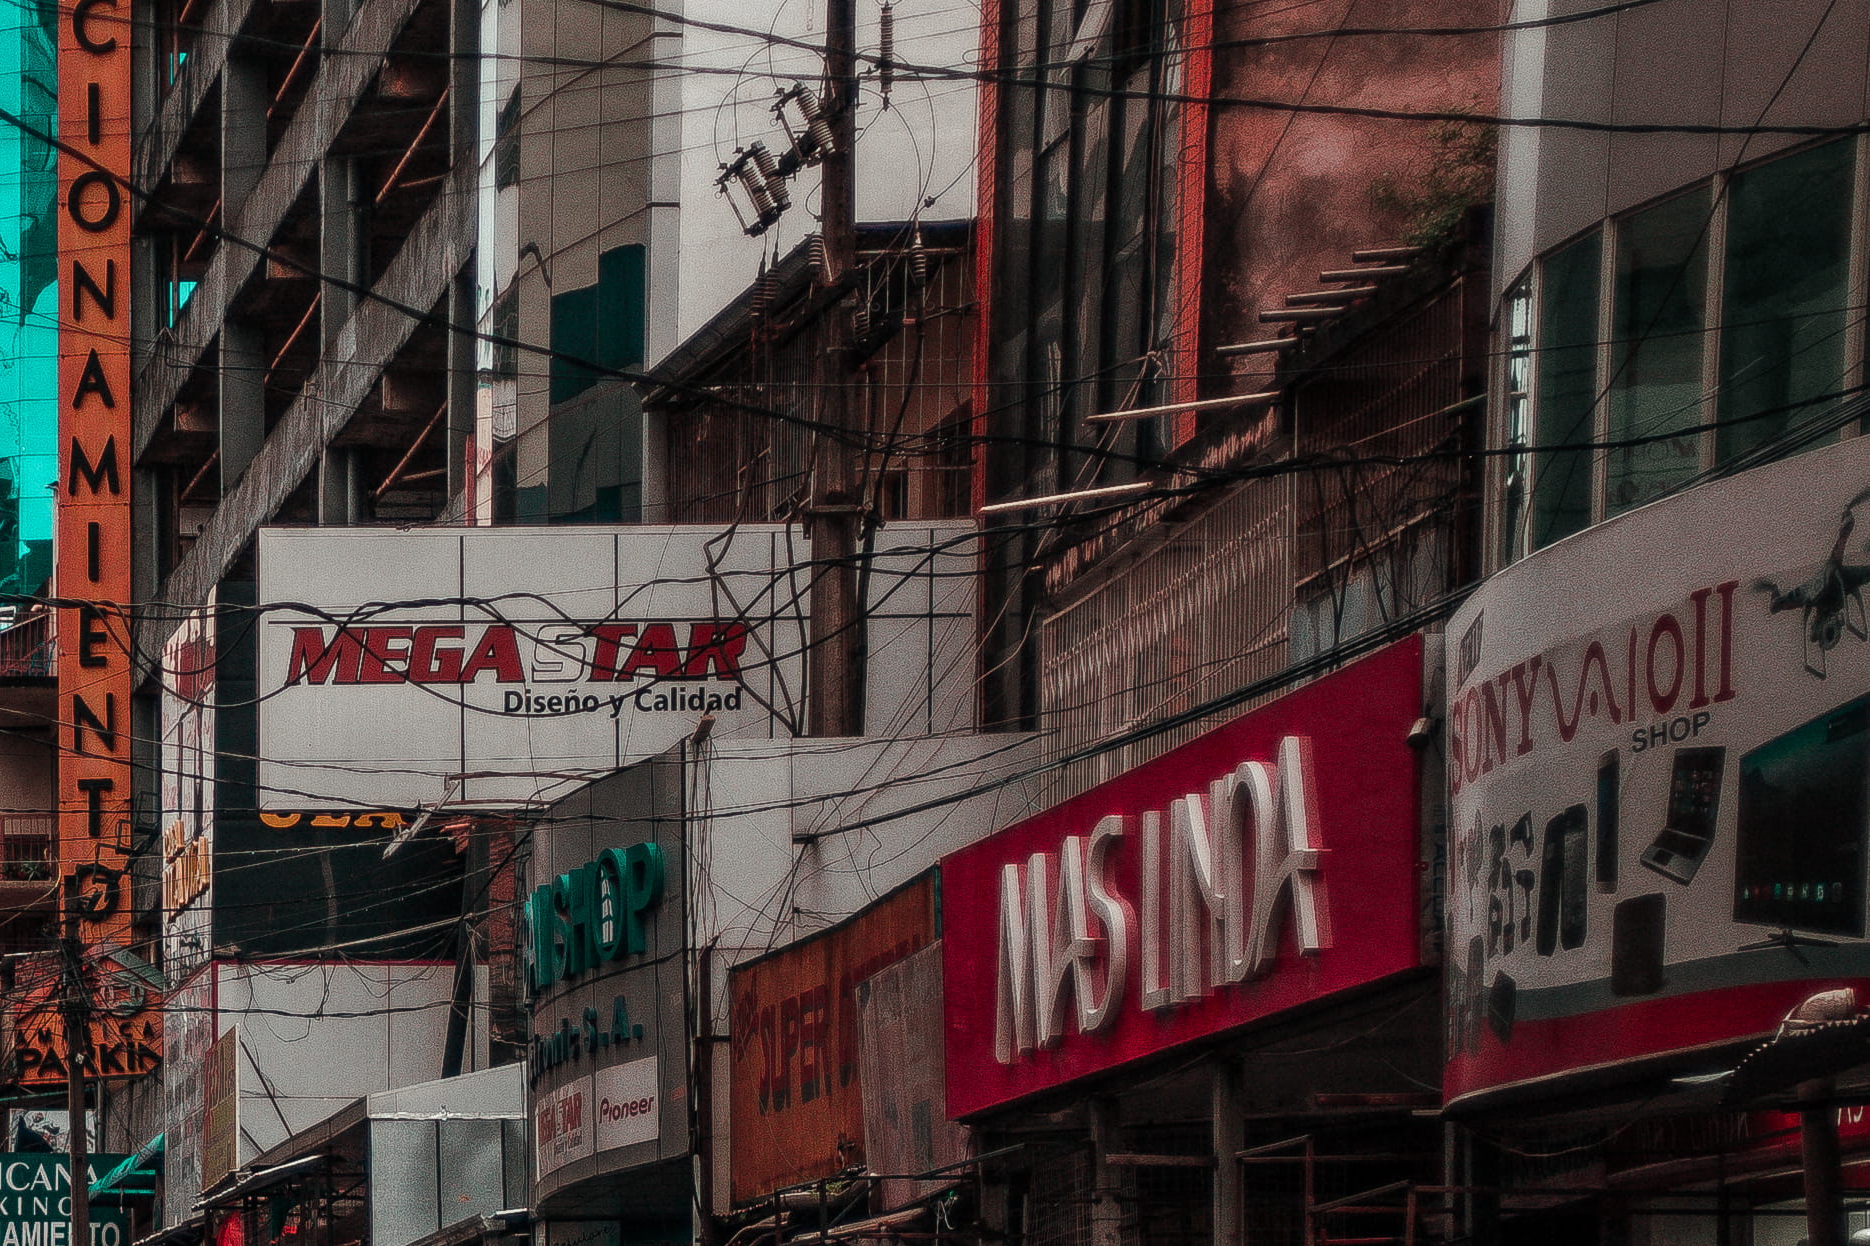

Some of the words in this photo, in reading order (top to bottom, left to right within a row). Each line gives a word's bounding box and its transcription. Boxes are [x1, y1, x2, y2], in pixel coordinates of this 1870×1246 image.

[504, 687, 600, 713] Diseño
[609, 694, 624, 719] y
[635, 686, 743, 713] Calidad
[1453, 654, 1542, 796] SONY
[1631, 711, 1711, 754] SHOP
[995, 814, 1136, 1065] MAS
[1140, 736, 1333, 1012] LINDA
[599, 1096, 654, 1124] Pioneer
